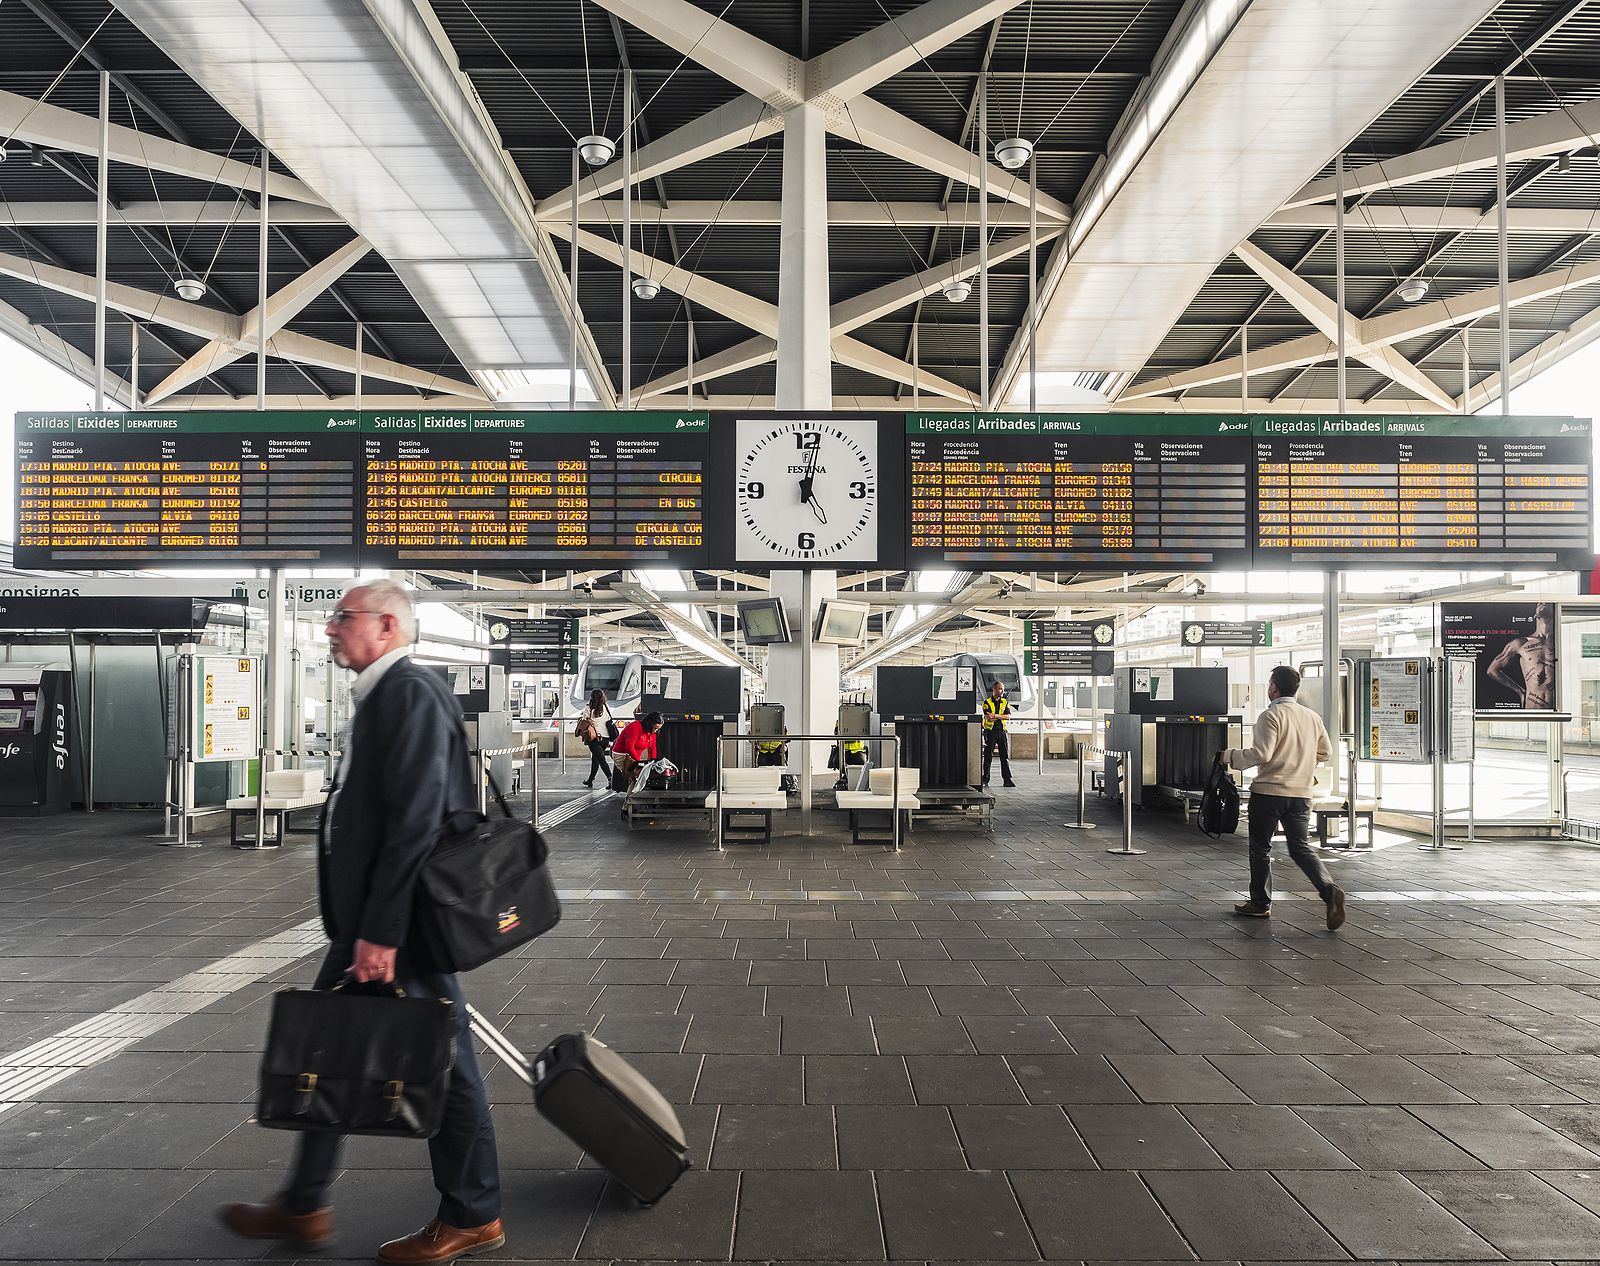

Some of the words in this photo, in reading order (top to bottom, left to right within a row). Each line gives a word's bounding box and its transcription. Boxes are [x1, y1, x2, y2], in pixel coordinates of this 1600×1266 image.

[28, 417, 69, 428] Salidas
[78, 417, 119, 428] Eixides
[128, 420, 178, 428] DEPARTURES
[375, 417, 416, 428] Salidas
[424, 417, 466, 428] Eixides
[474, 420, 525, 428] DEPARTURES
[920, 418, 970, 431] Llegadas
[978, 418, 1036, 429] Arribades
[1043, 422, 1080, 430] ARRIVALS
[1229, 422, 1249, 430] adif
[1265, 420, 1315, 433] Llegadas
[1323, 420, 1380, 431] Arribades
[1387, 424, 1424, 432] ARRIVALS
[793, 432, 821, 449] 12
[53, 462, 88, 470] MADRID
[94, 462, 116, 470] PTA.
[124, 462, 160, 470] ATOCHA
[163, 462, 180, 470] AVE
[400, 461, 435, 470] MADRID
[441, 461, 463, 470] PTA.
[471, 461, 507, 470] ATOCHA
[510, 461, 527, 470] AVE
[912, 463, 942, 472] 17:24
[945, 463, 980, 472] MADRID
[986, 463, 1008, 472] PTA.
[1016, 463, 1051, 472] ATOCHA
[1055, 463, 1072, 472] AVE
[52, 475, 106, 483] BARCELONA
[162, 475, 204, 483] EUROMED
[400, 474, 435, 482] MADRID
[441, 474, 463, 482] PTA.
[471, 474, 506, 482] ATOCHA
[510, 474, 551, 482] INTERCI
[659, 474, 701, 482] CIRCULA
[912, 475, 942, 484] 17:42
[945, 475, 998, 484] BARCELONA
[1055, 476, 1096, 485] EUROMED
[52, 487, 88, 495] MADRID
[94, 487, 116, 495] PTA.
[124, 487, 160, 495] ATOCHA
[162, 487, 180, 495] AVE
[400, 486, 494, 495] ALACANT/ALICANTE
[510, 486, 551, 495] EUROMED
[747, 482, 764, 499] 9
[849, 482, 866, 499] 3
[912, 488, 942, 497] 17:49
[945, 488, 1039, 497] ALACANT/ALICANTE
[1055, 488, 1096, 498] EUROMED
[52, 499, 106, 508] BARCELONA
[162, 499, 204, 508] EUROMED
[210, 499, 239, 508] 01192
[509, 499, 527, 507] AVE
[659, 499, 671, 508] EN
[677, 499, 695, 508] BUS
[945, 500, 980, 510] MADRID
[986, 500, 1008, 510] PTA.
[1016, 500, 1051, 510] ATOCHA
[1055, 501, 1084, 510] ALVIA
[162, 512, 192, 520] ALVIA
[399, 511, 452, 520] BARCELONA
[509, 511, 551, 520] EUROMED
[945, 513, 998, 522] BARCELONA
[1055, 514, 1096, 523] EUROMED
[52, 524, 88, 533] MADRID
[94, 524, 116, 533] PTA.
[124, 524, 159, 533] ATOCHA
[162, 524, 180, 533] AVE
[399, 523, 434, 532] MADRID
[441, 523, 463, 532] PTA.
[470, 523, 506, 532] ATOCHA
[509, 524, 527, 532] AVE
[636, 524, 678, 532] CIRCULA
[912, 525, 942, 534] 19:22
[945, 525, 980, 534] MADRID
[986, 525, 1008, 534] PTA.
[1016, 525, 1051, 534] ATOCHA
[1055, 526, 1072, 535] AVE
[52, 536, 147, 545] ALACANT/ALICANTE
[162, 536, 203, 545] EUROMED
[399, 536, 434, 545] MADRID
[441, 536, 462, 545] PTA.
[470, 536, 506, 545] ATOCHA
[509, 536, 527, 545] AVE
[636, 536, 648, 545] DE
[798, 532, 815, 549] 6
[945, 538, 980, 547] MADRID
[986, 538, 1008, 547] PTA.
[1016, 538, 1051, 547] ATOCHA
[1055, 538, 1072, 547] AVE
[563, 632, 571, 642] 4
[1032, 634, 1038, 643] 3
[1259, 634, 1265, 644] 2
[563, 662, 571, 672] 4
[1032, 663, 1038, 673] 3
[53, 703, 69, 770] renfe
